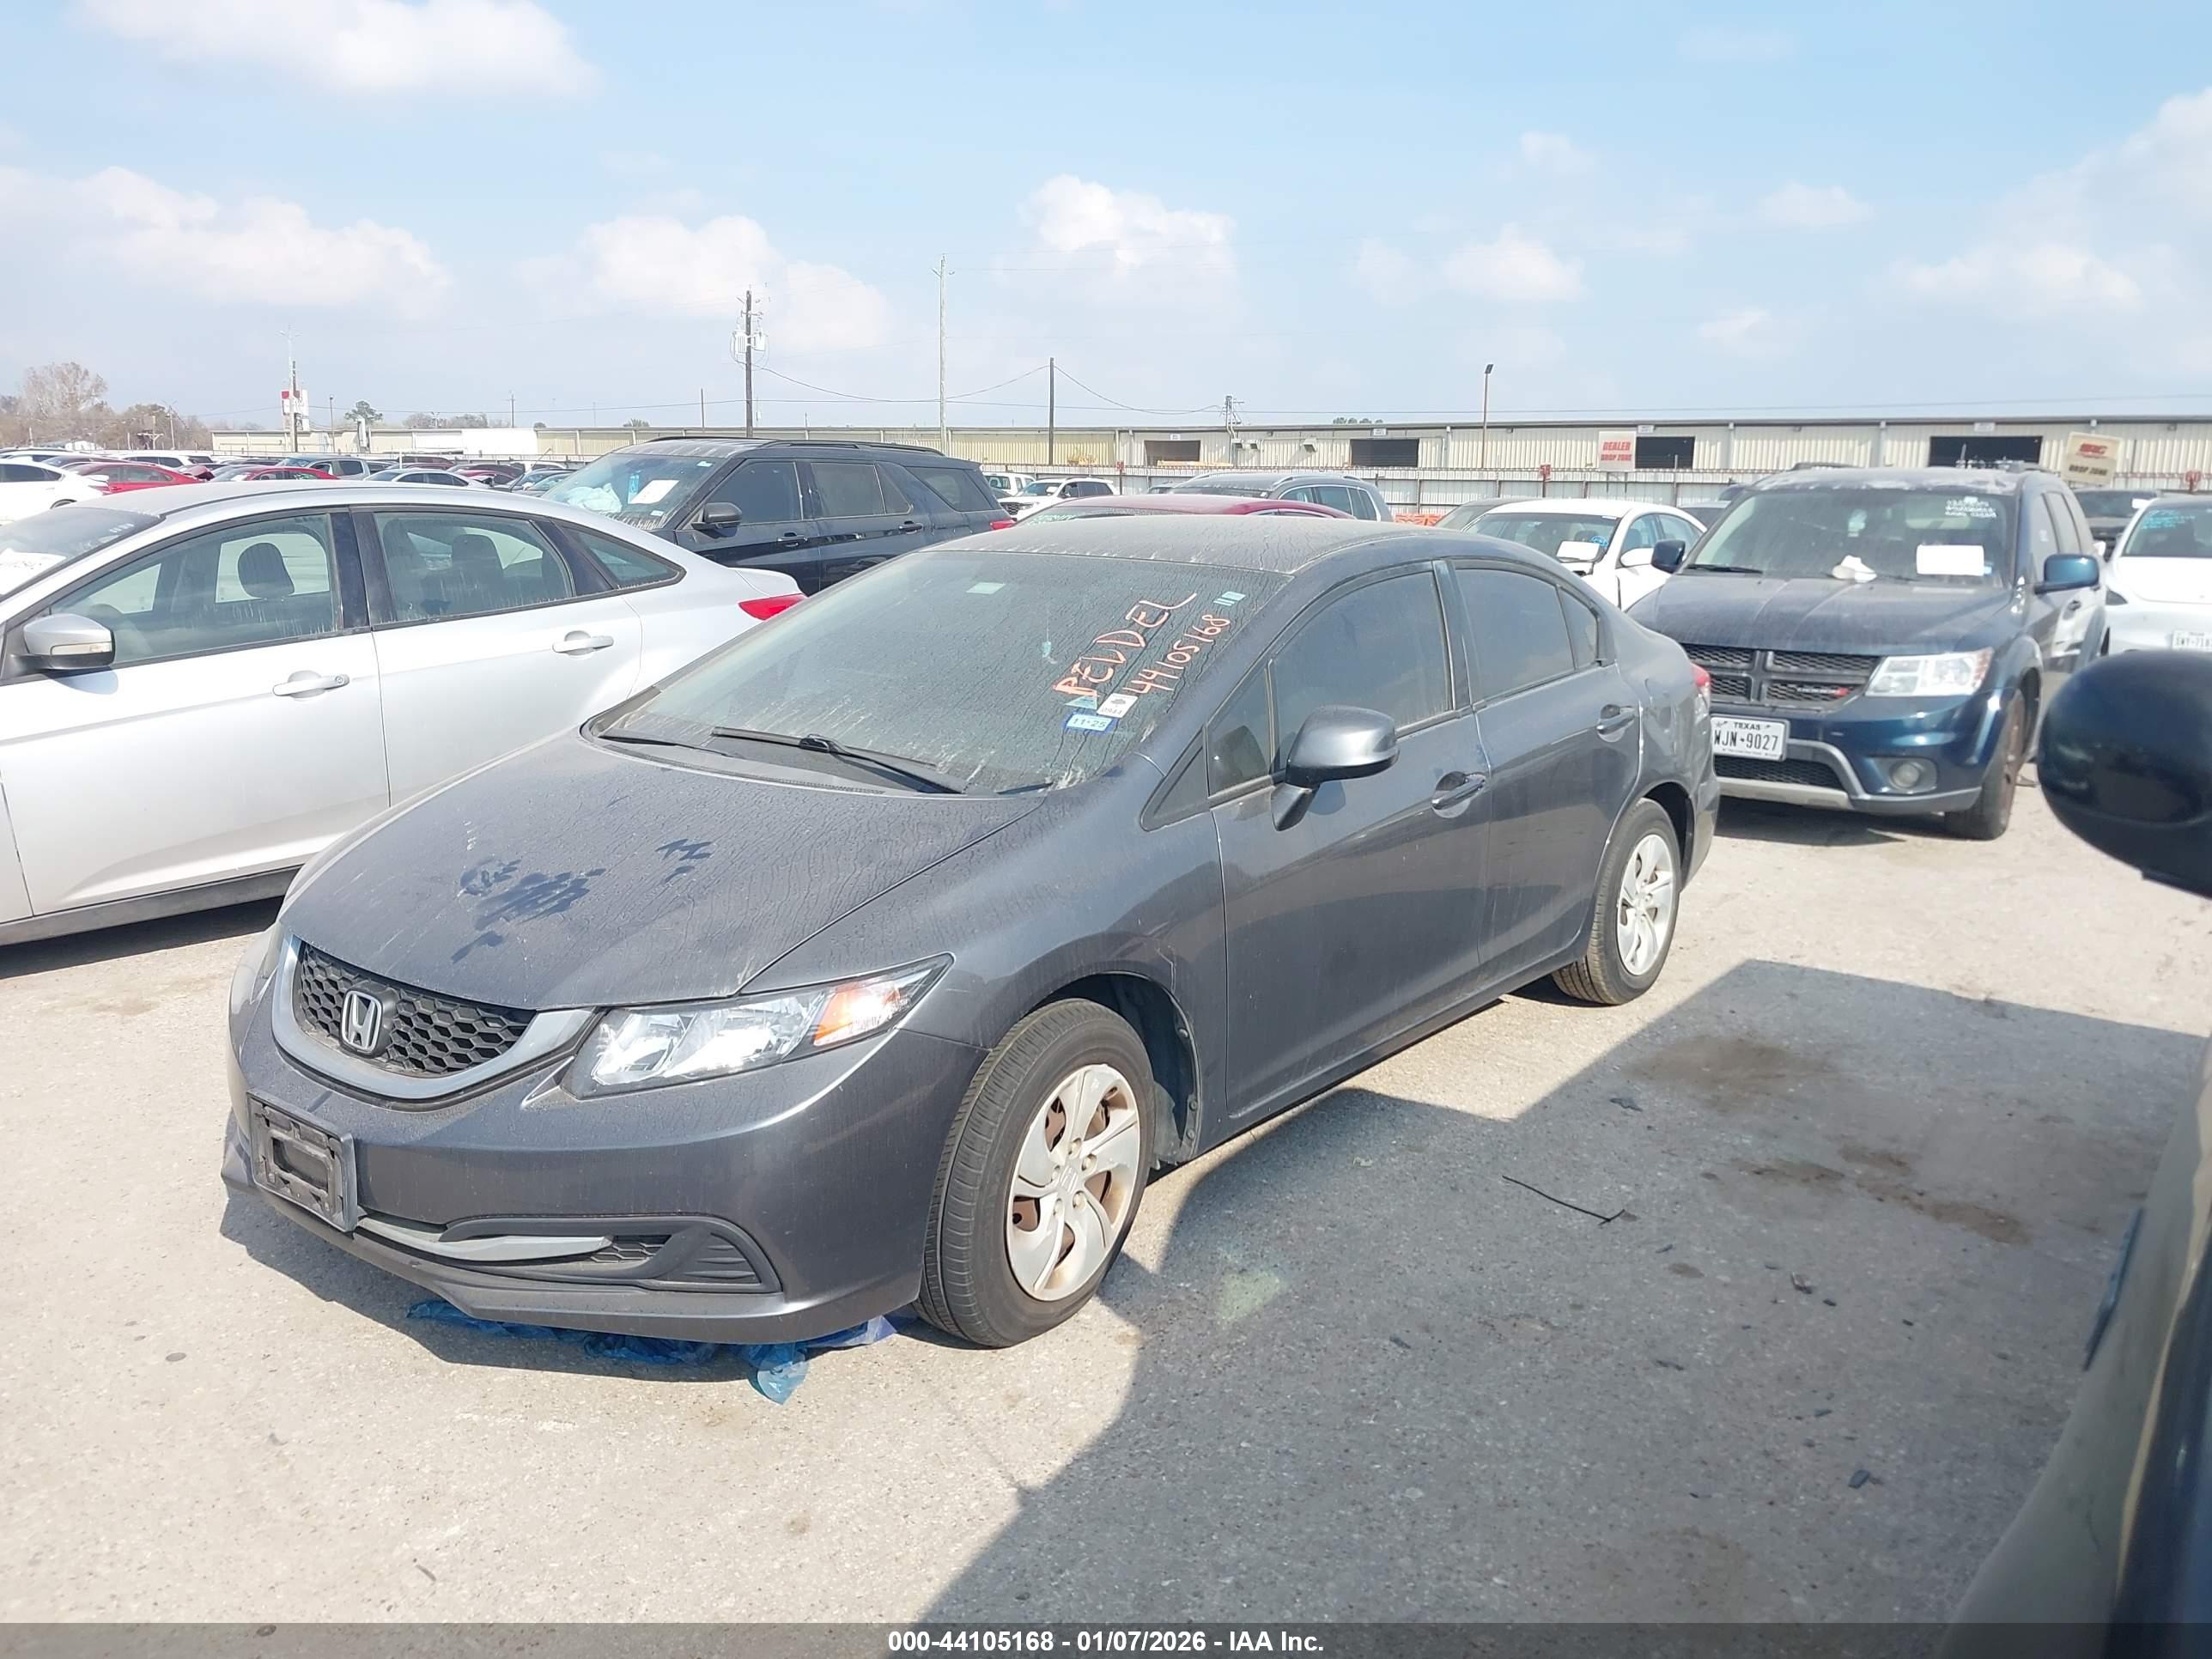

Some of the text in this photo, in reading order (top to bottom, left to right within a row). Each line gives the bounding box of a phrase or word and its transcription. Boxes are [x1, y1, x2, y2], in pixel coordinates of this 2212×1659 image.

[1602, 441, 1632, 451] DEALER
[1122, 614, 1231, 692] 44105168
[1735, 722, 1760, 731] TEXAS
